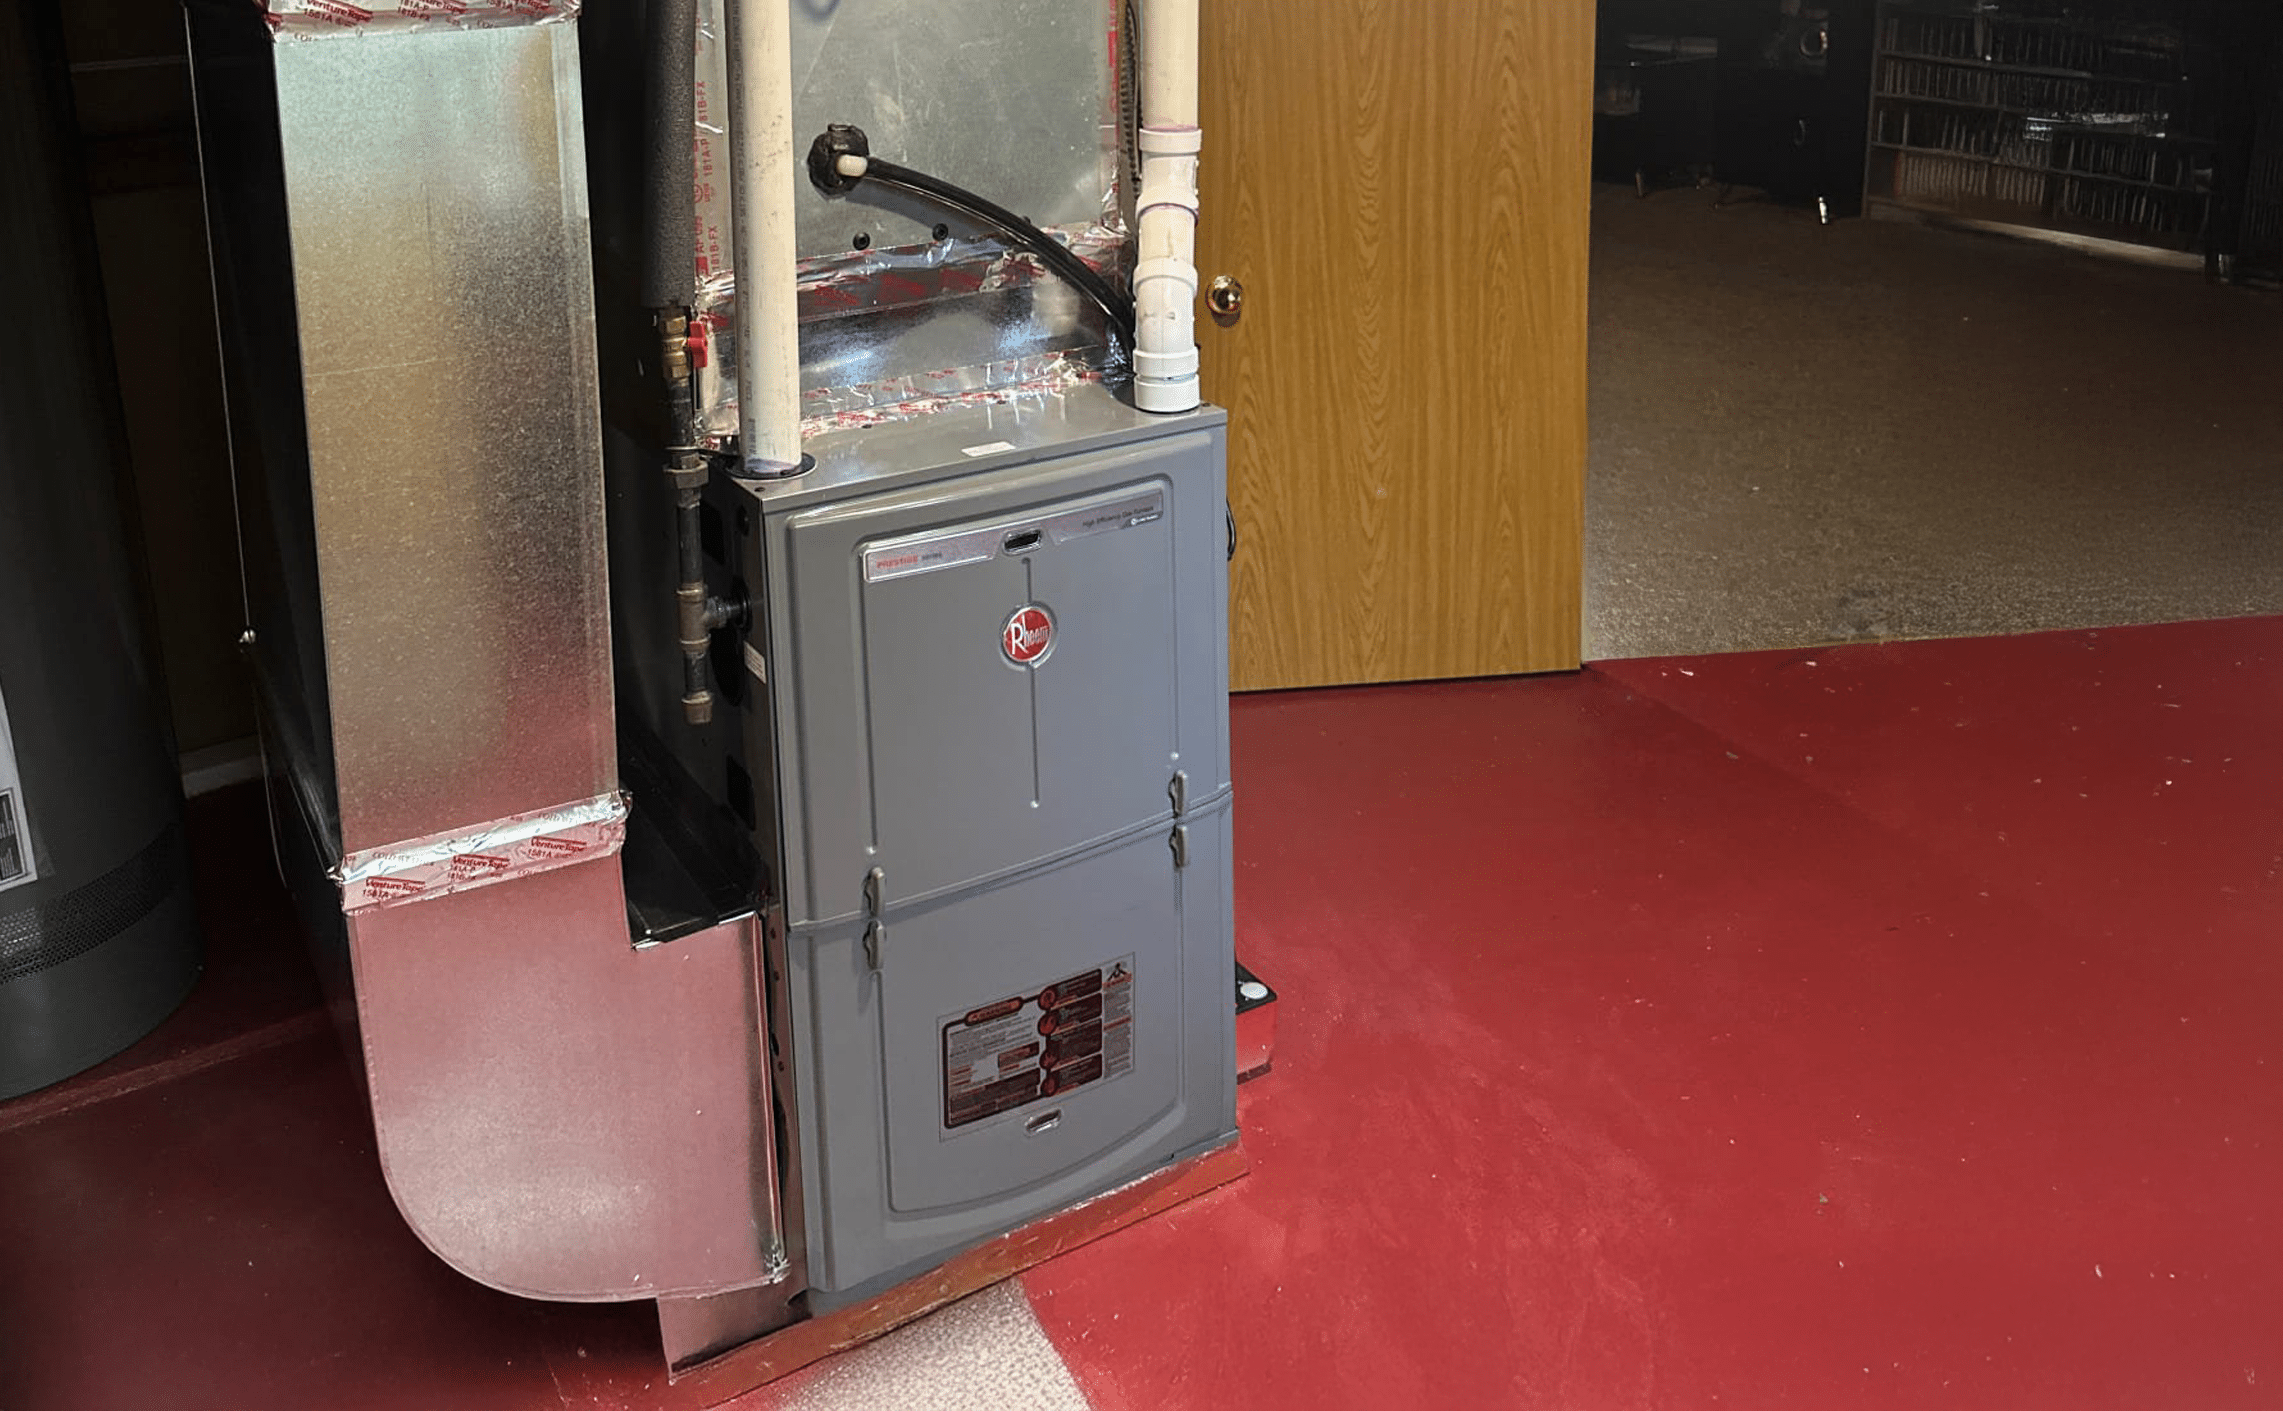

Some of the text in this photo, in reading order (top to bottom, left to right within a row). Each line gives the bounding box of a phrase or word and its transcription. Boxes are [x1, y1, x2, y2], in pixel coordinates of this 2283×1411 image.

[696, 81, 709, 122] 81B-FX
[708, 225, 720, 271] 181B-FX
[1010, 614, 1052, 655] Rheem
